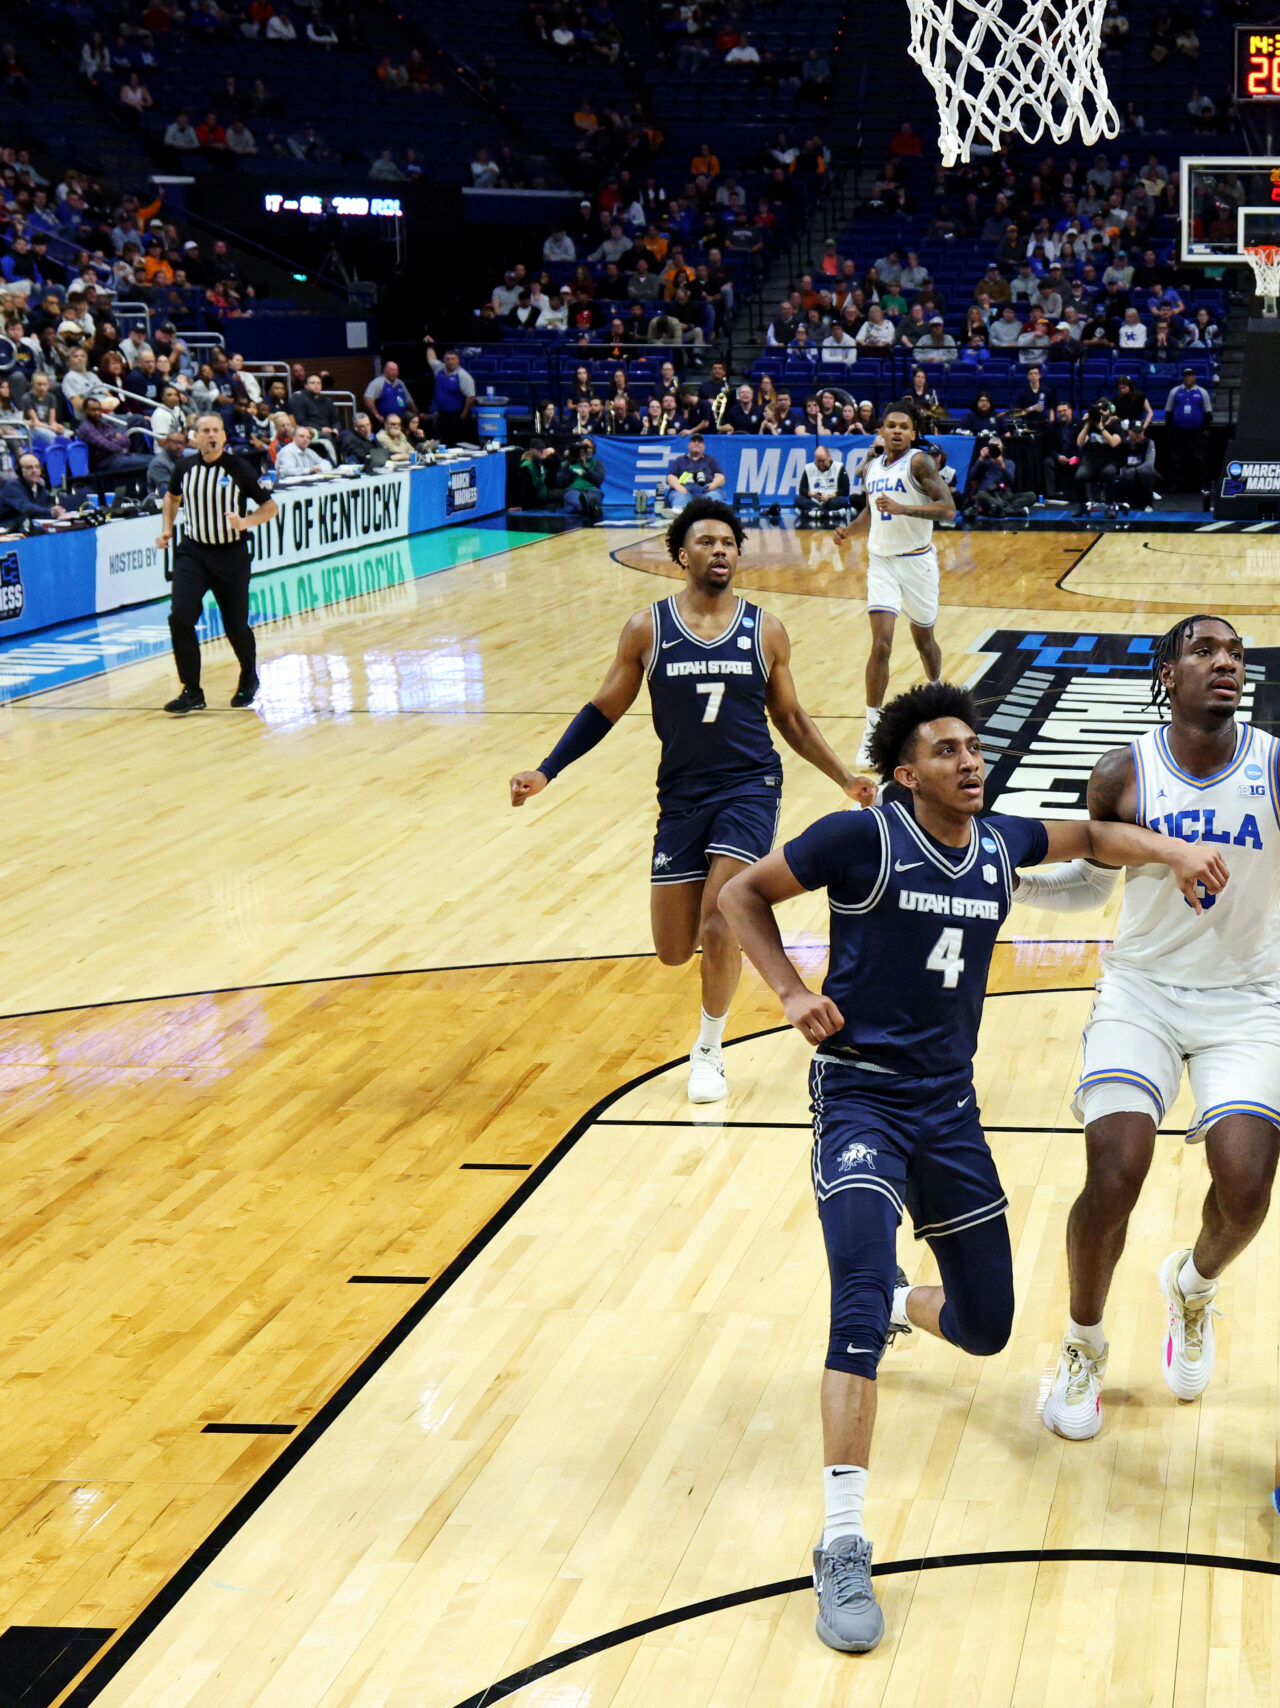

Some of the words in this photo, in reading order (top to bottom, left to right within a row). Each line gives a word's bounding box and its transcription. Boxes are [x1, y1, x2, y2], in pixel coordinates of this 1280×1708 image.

[867, 477, 907, 495] UCLA
[292, 498, 313, 551] OF
[318, 481, 402, 545] KENTUCKY
[109, 548, 143, 575] HOSTED
[145, 547, 157, 567] BY
[666, 660, 707, 677] UTAH
[707, 660, 753, 676] STATE
[695, 682, 726, 723] 7
[898, 889, 951, 915] UTAH
[951, 896, 1000, 921] STATE
[925, 927, 965, 989] 4
